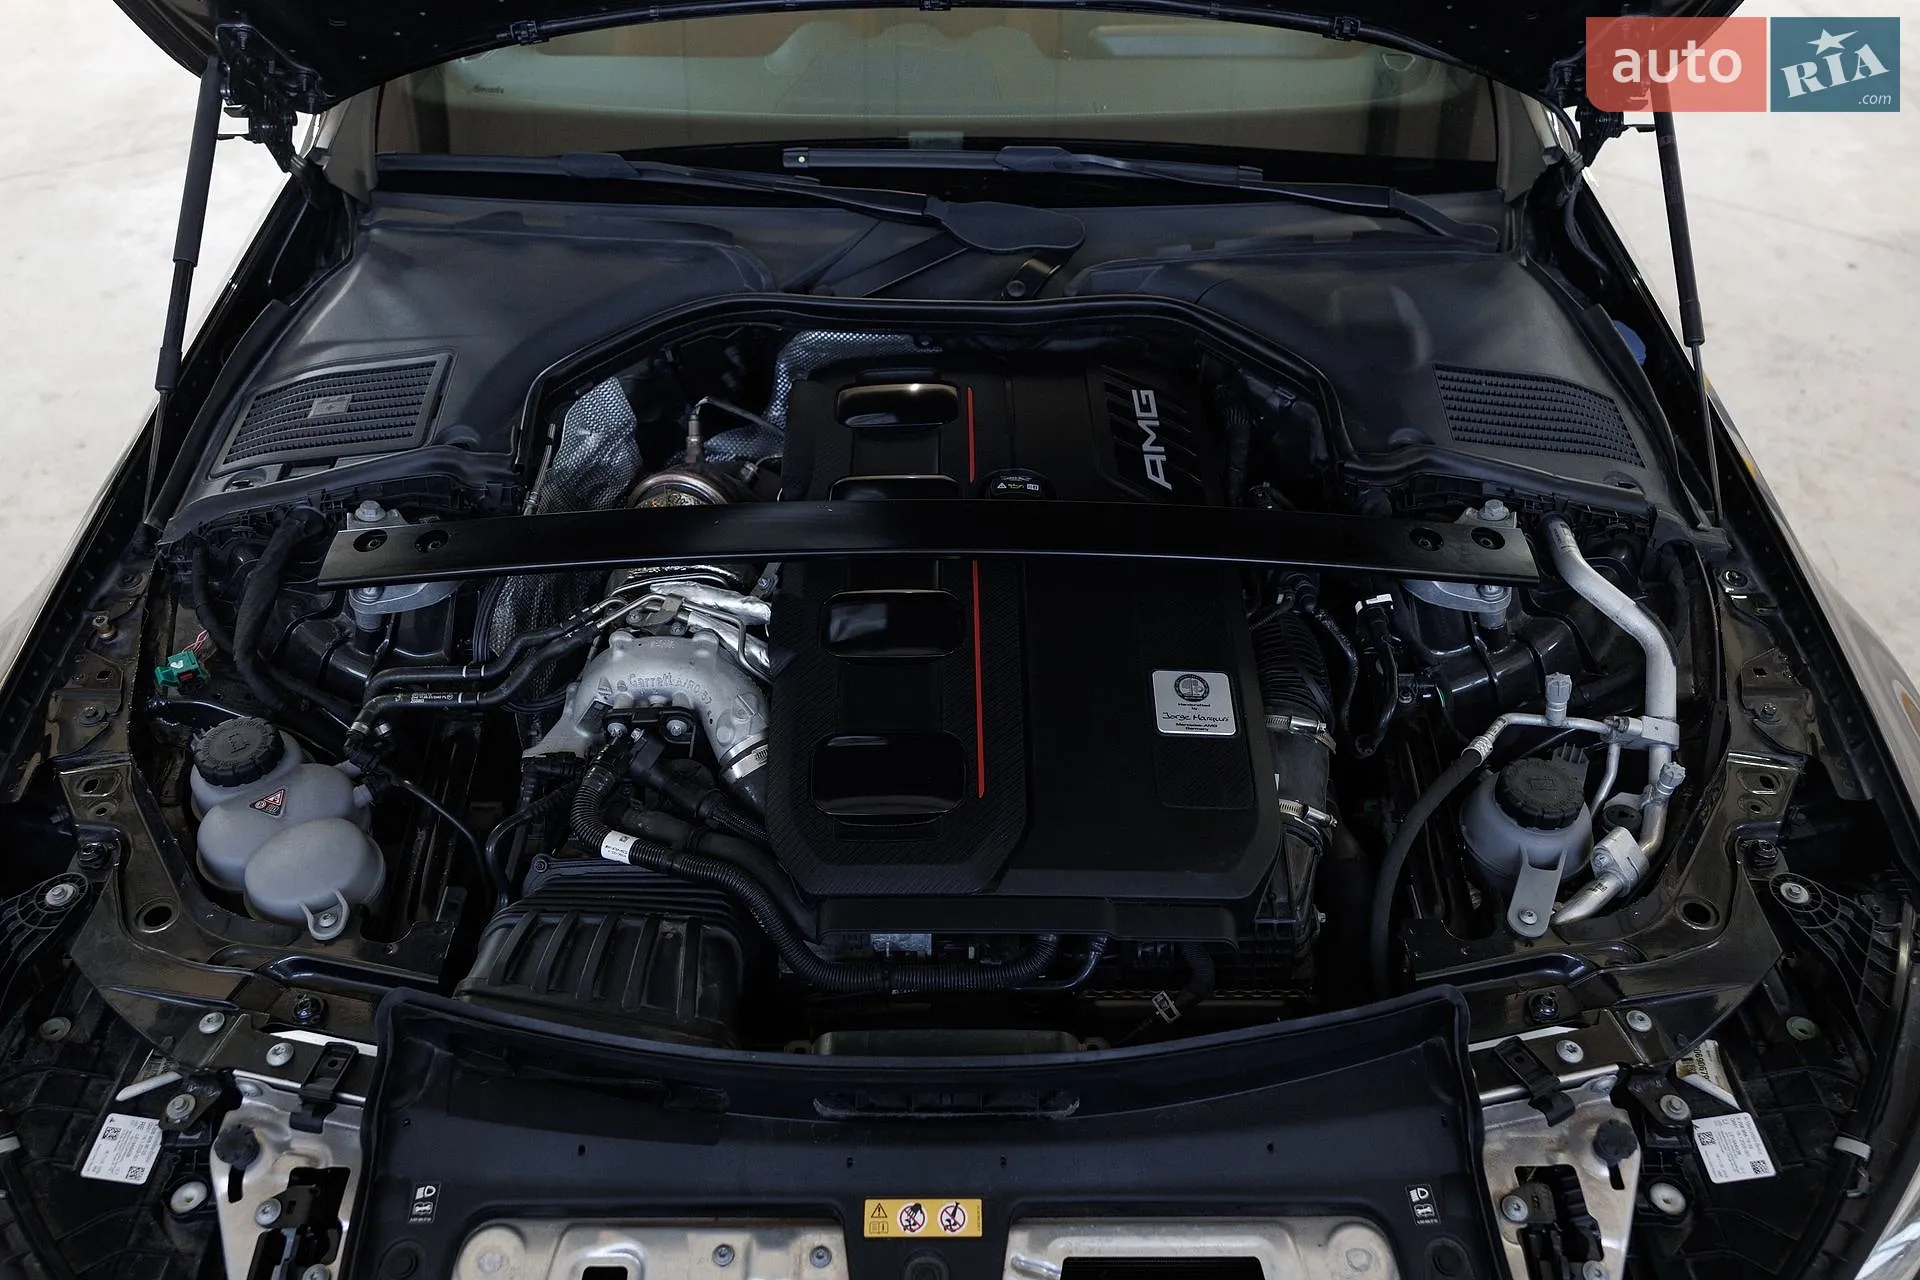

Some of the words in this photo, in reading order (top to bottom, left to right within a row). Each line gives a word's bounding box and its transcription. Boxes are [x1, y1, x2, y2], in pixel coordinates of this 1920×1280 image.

[1131, 389, 1172, 490] AMG
[630, 672, 673, 688] Garrett
[1162, 712, 1191, 721] Jorge
